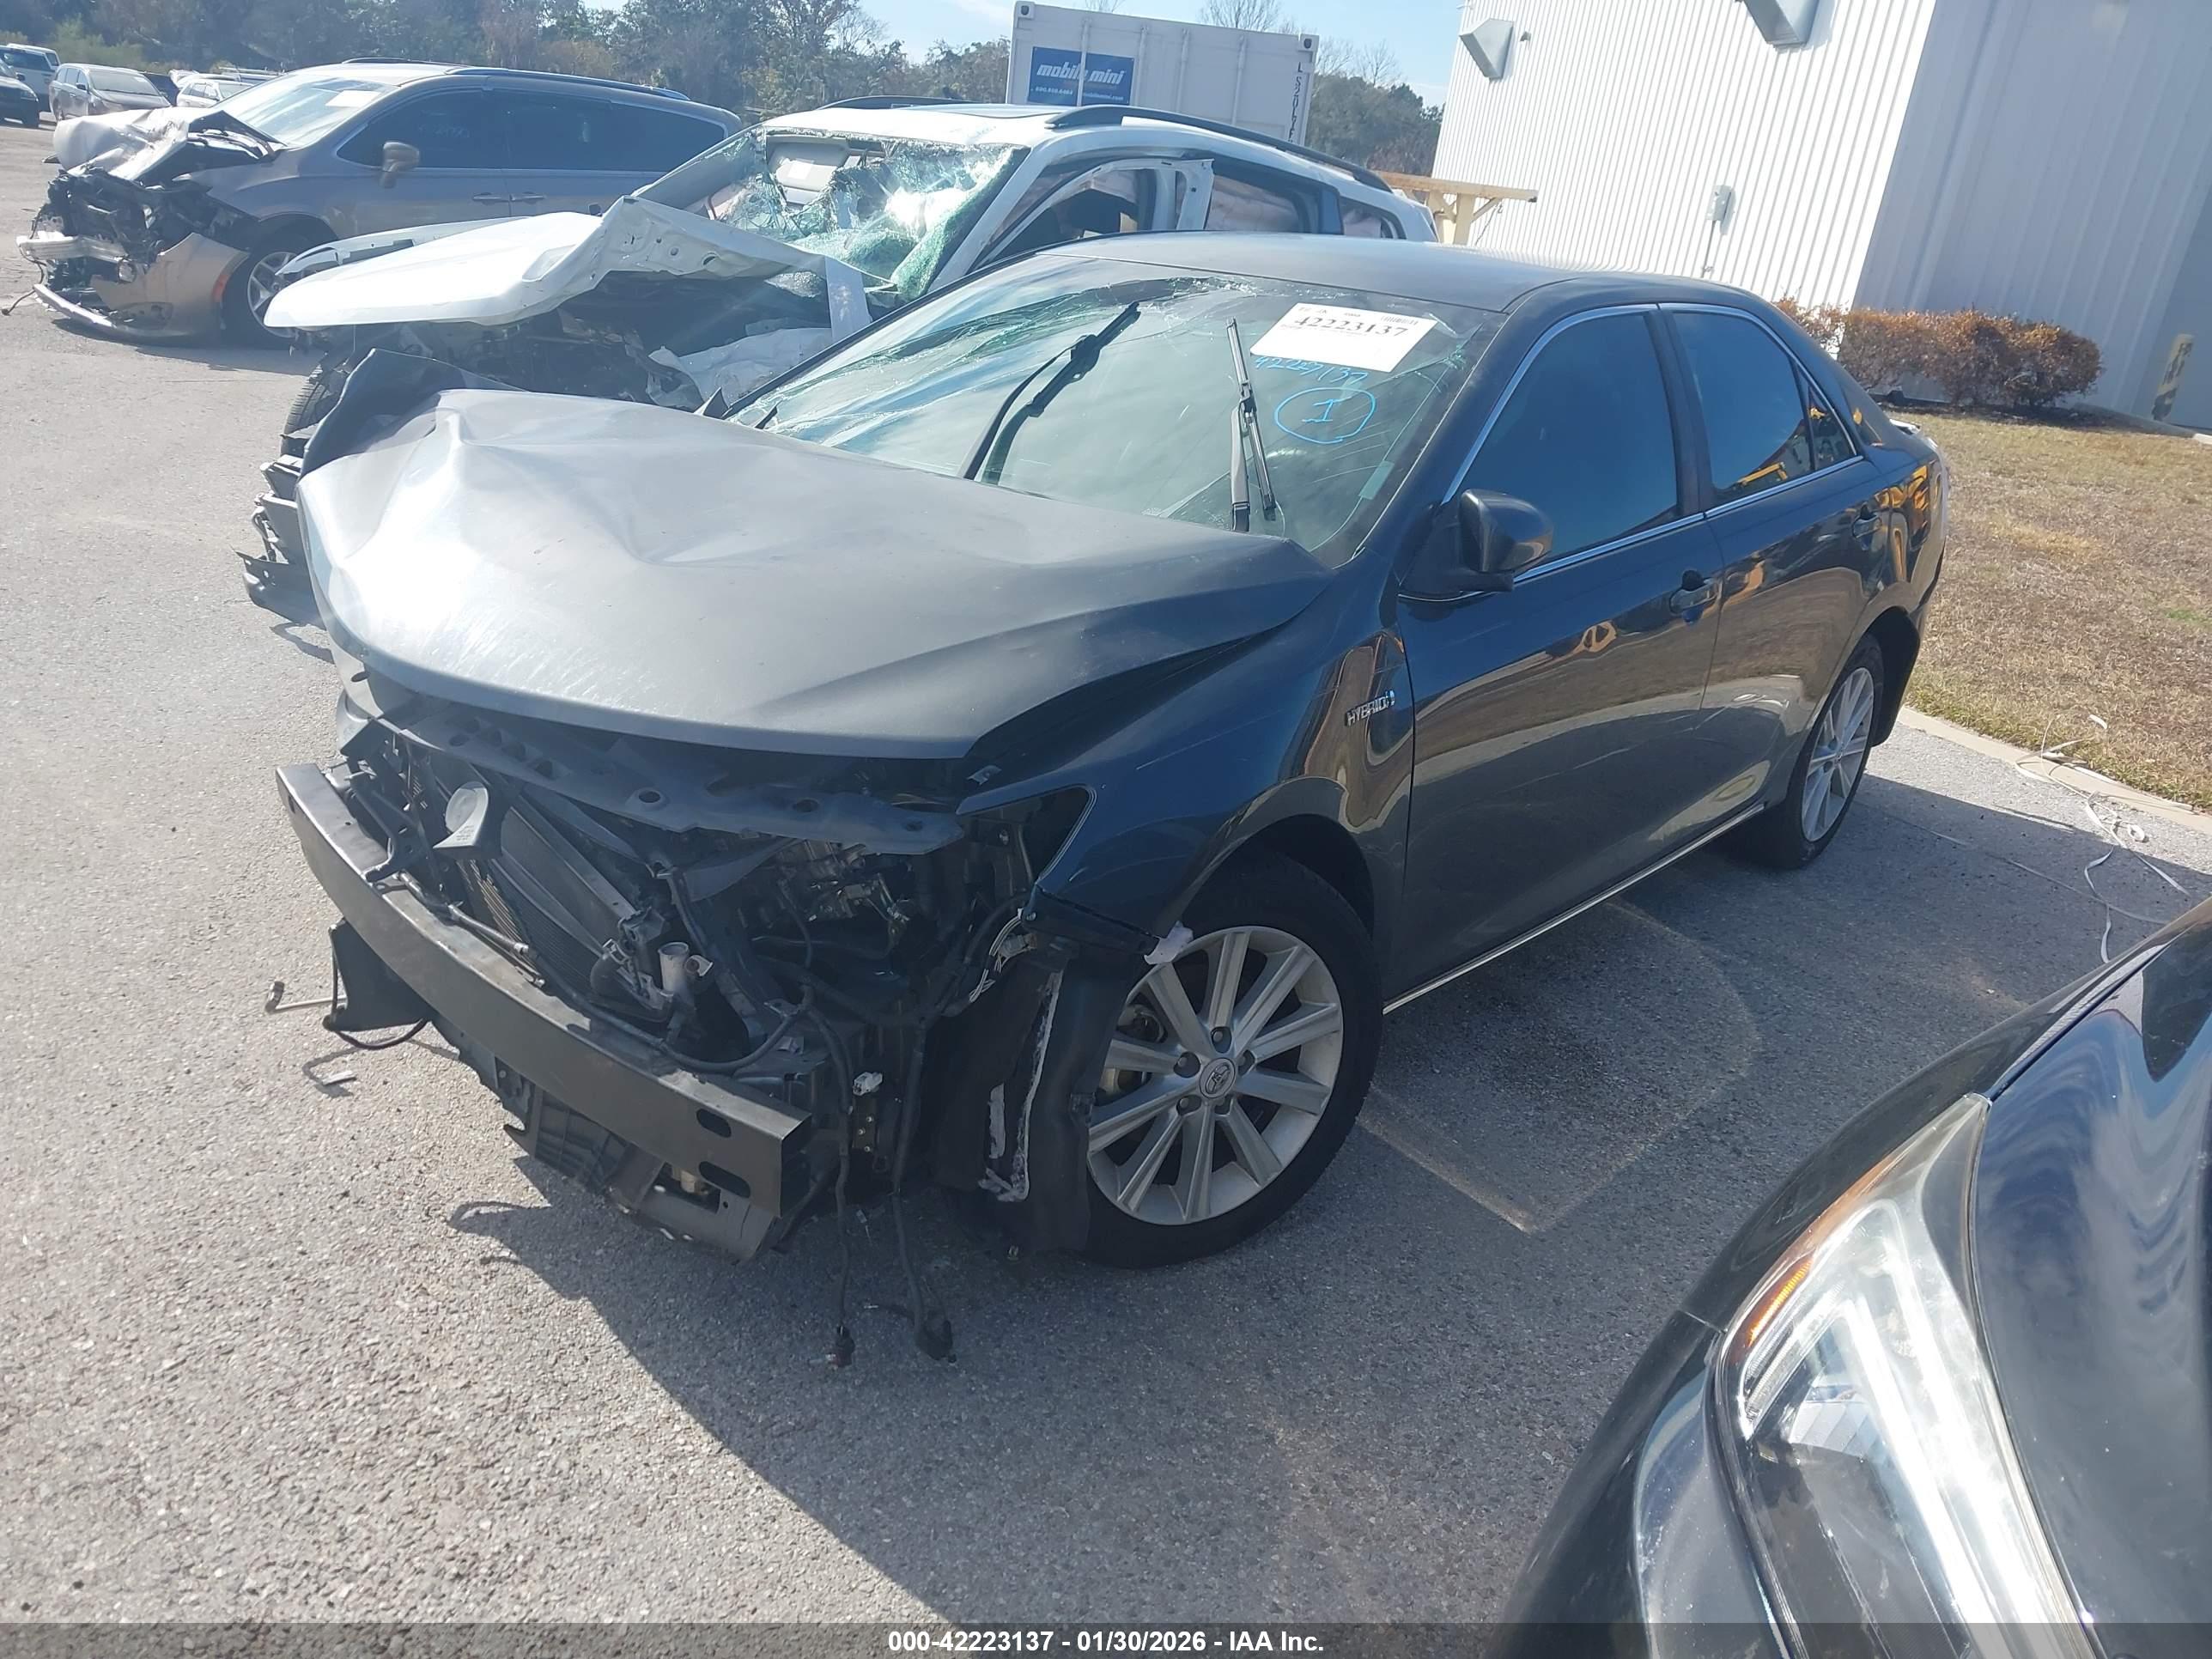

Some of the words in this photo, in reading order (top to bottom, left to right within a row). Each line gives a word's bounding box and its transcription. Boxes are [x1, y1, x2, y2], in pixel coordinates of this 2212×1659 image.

[1088, 69, 1125, 85] mini
[1294, 315, 1409, 337] 42223137
[1346, 696, 1388, 726] HYBRID
